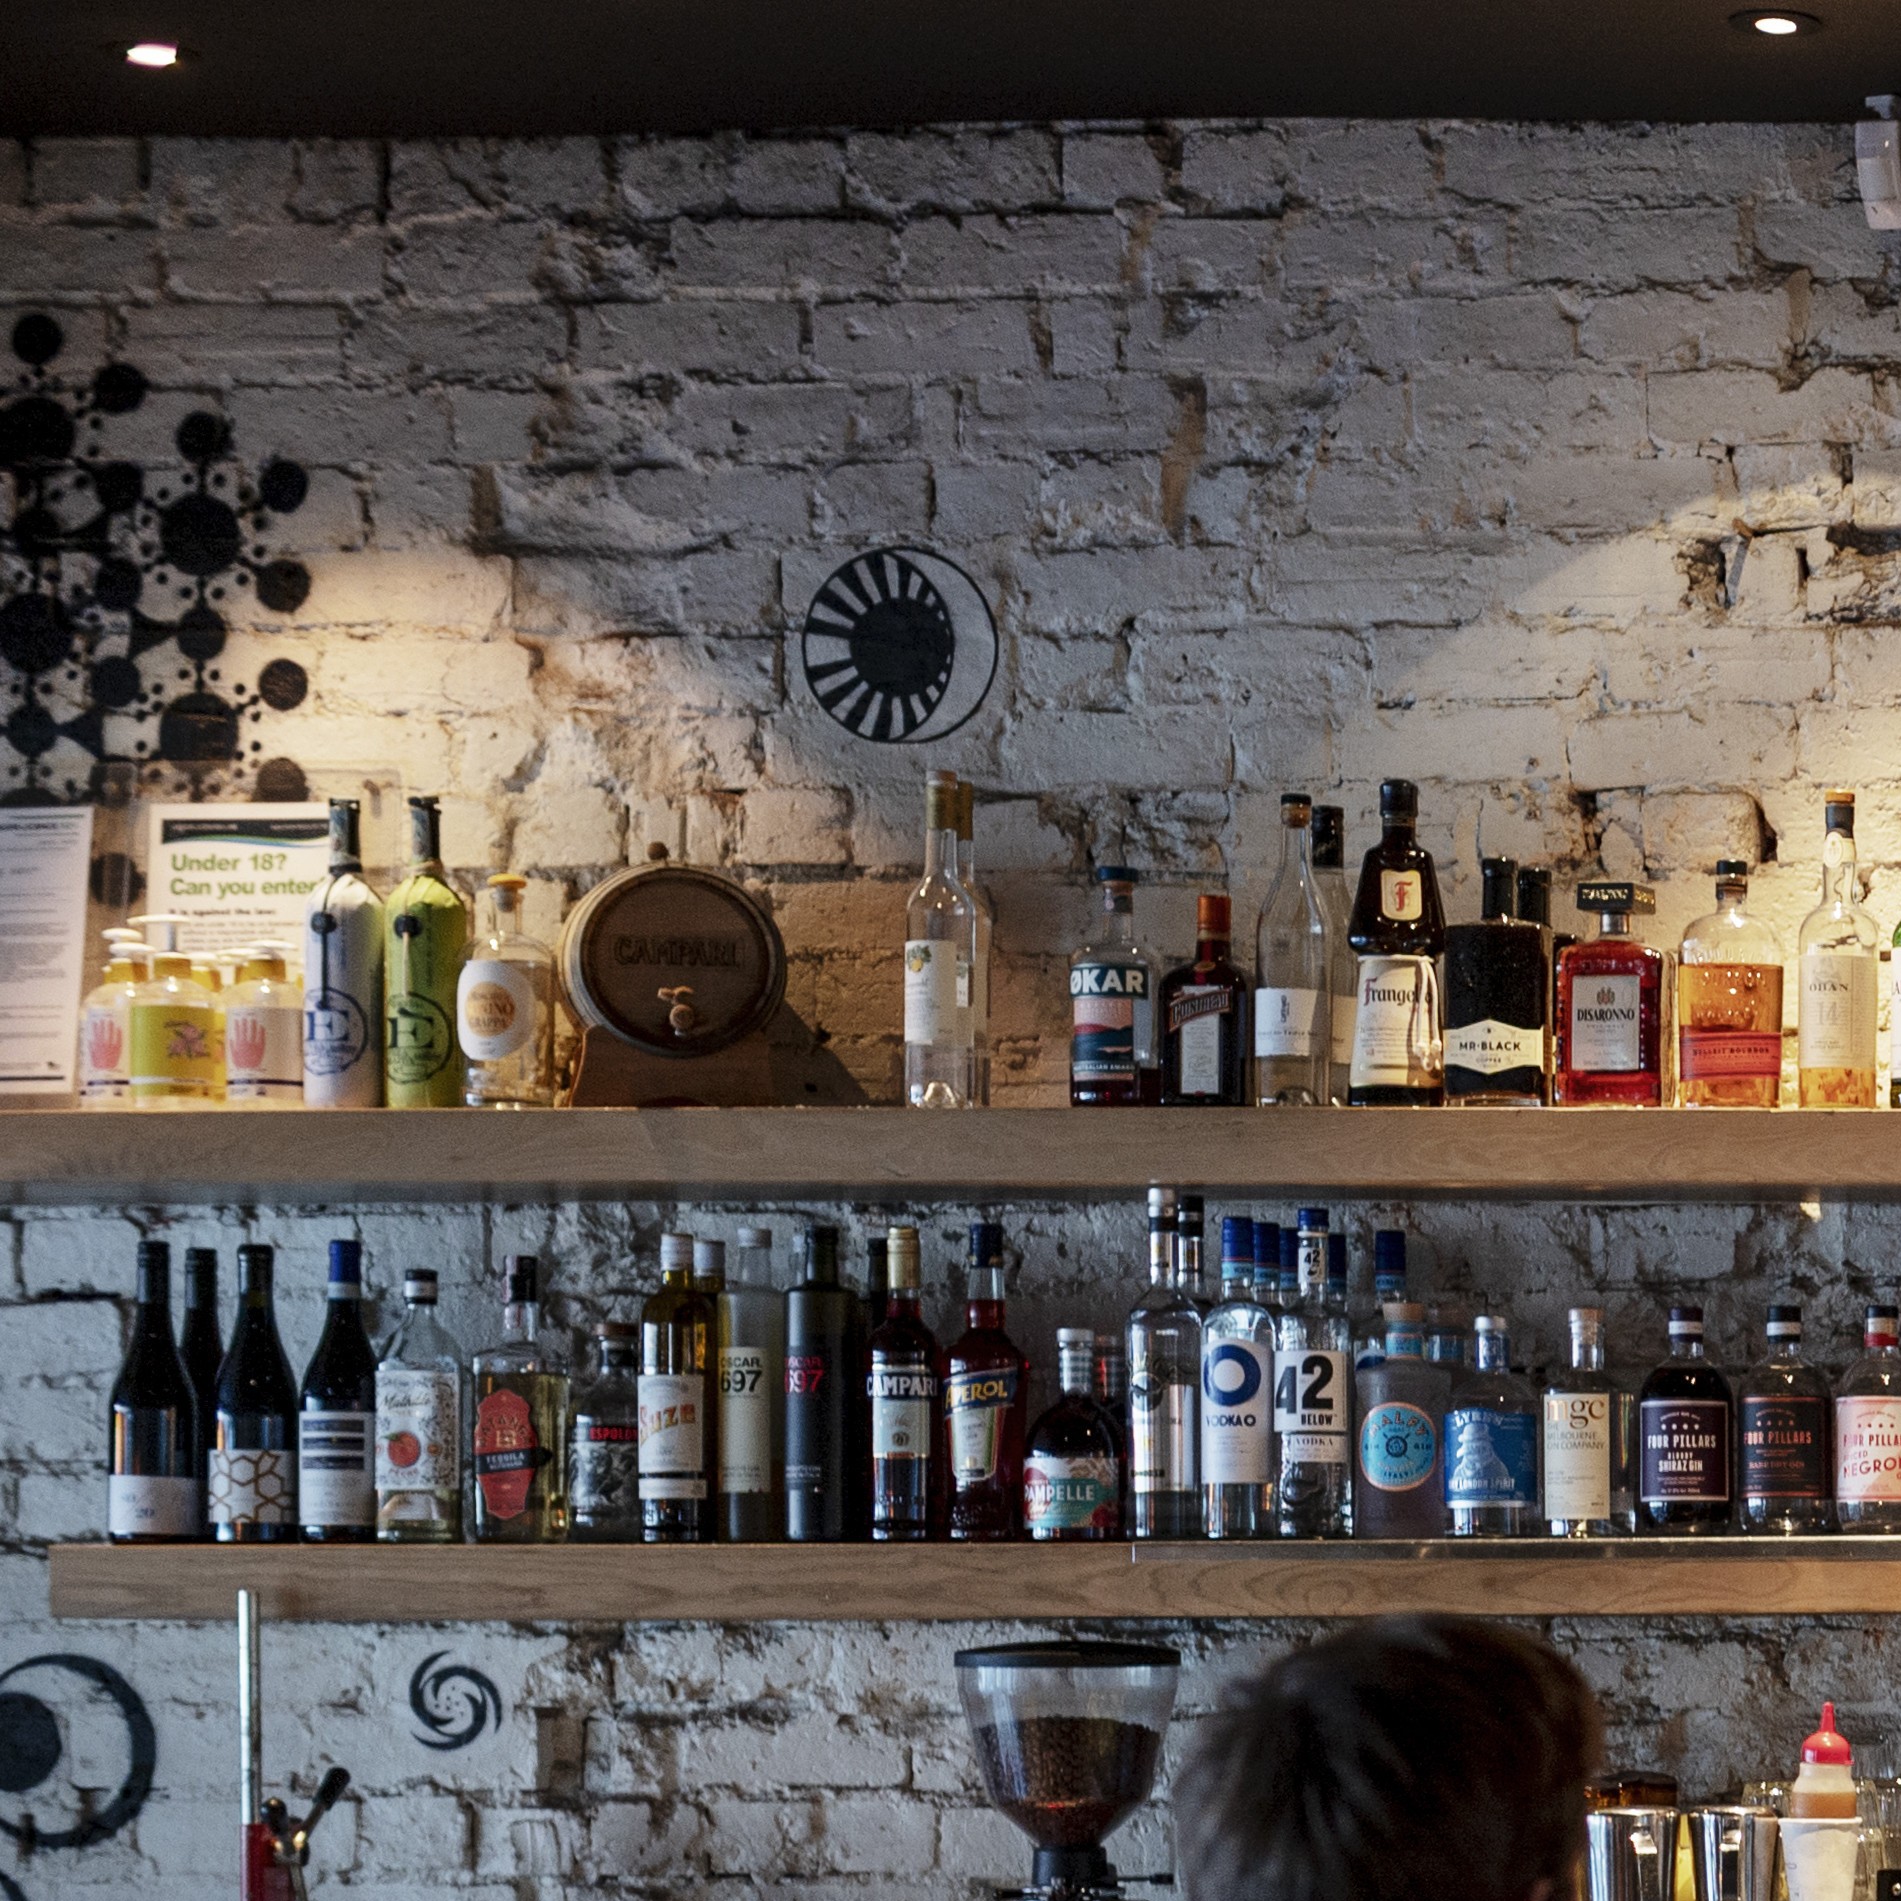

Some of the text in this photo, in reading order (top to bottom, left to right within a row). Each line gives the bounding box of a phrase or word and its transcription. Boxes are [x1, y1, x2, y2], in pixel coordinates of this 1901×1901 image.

[171, 853, 287, 871] Under 18?
[171, 878, 322, 899] Can you enter
[1070, 968, 1143, 994] ØKAR
[1577, 1008, 1635, 1021] DISARONNO
[1304, 1250, 1321, 1263] 42
[721, 1370, 762, 1393] 697
[784, 1369, 824, 1393] 697
[867, 1375, 938, 1397] CAMPARI
[1276, 1355, 1334, 1414] 42
[945, 1380, 1008, 1408] APEROL
[1301, 1414, 1333, 1425] BELOW
[1547, 1398, 1606, 1429] mgc
[1295, 1437, 1334, 1447] VODKA
[1647, 1434, 1717, 1449] FOUR PILLARS
[1743, 1431, 1812, 1445] FOUR PILLARS
[1667, 1452, 1693, 1460] BLOODY
[1658, 1460, 1703, 1472] SHIRAZ GIN
[1024, 1484, 1095, 1501] PAMPELLE
